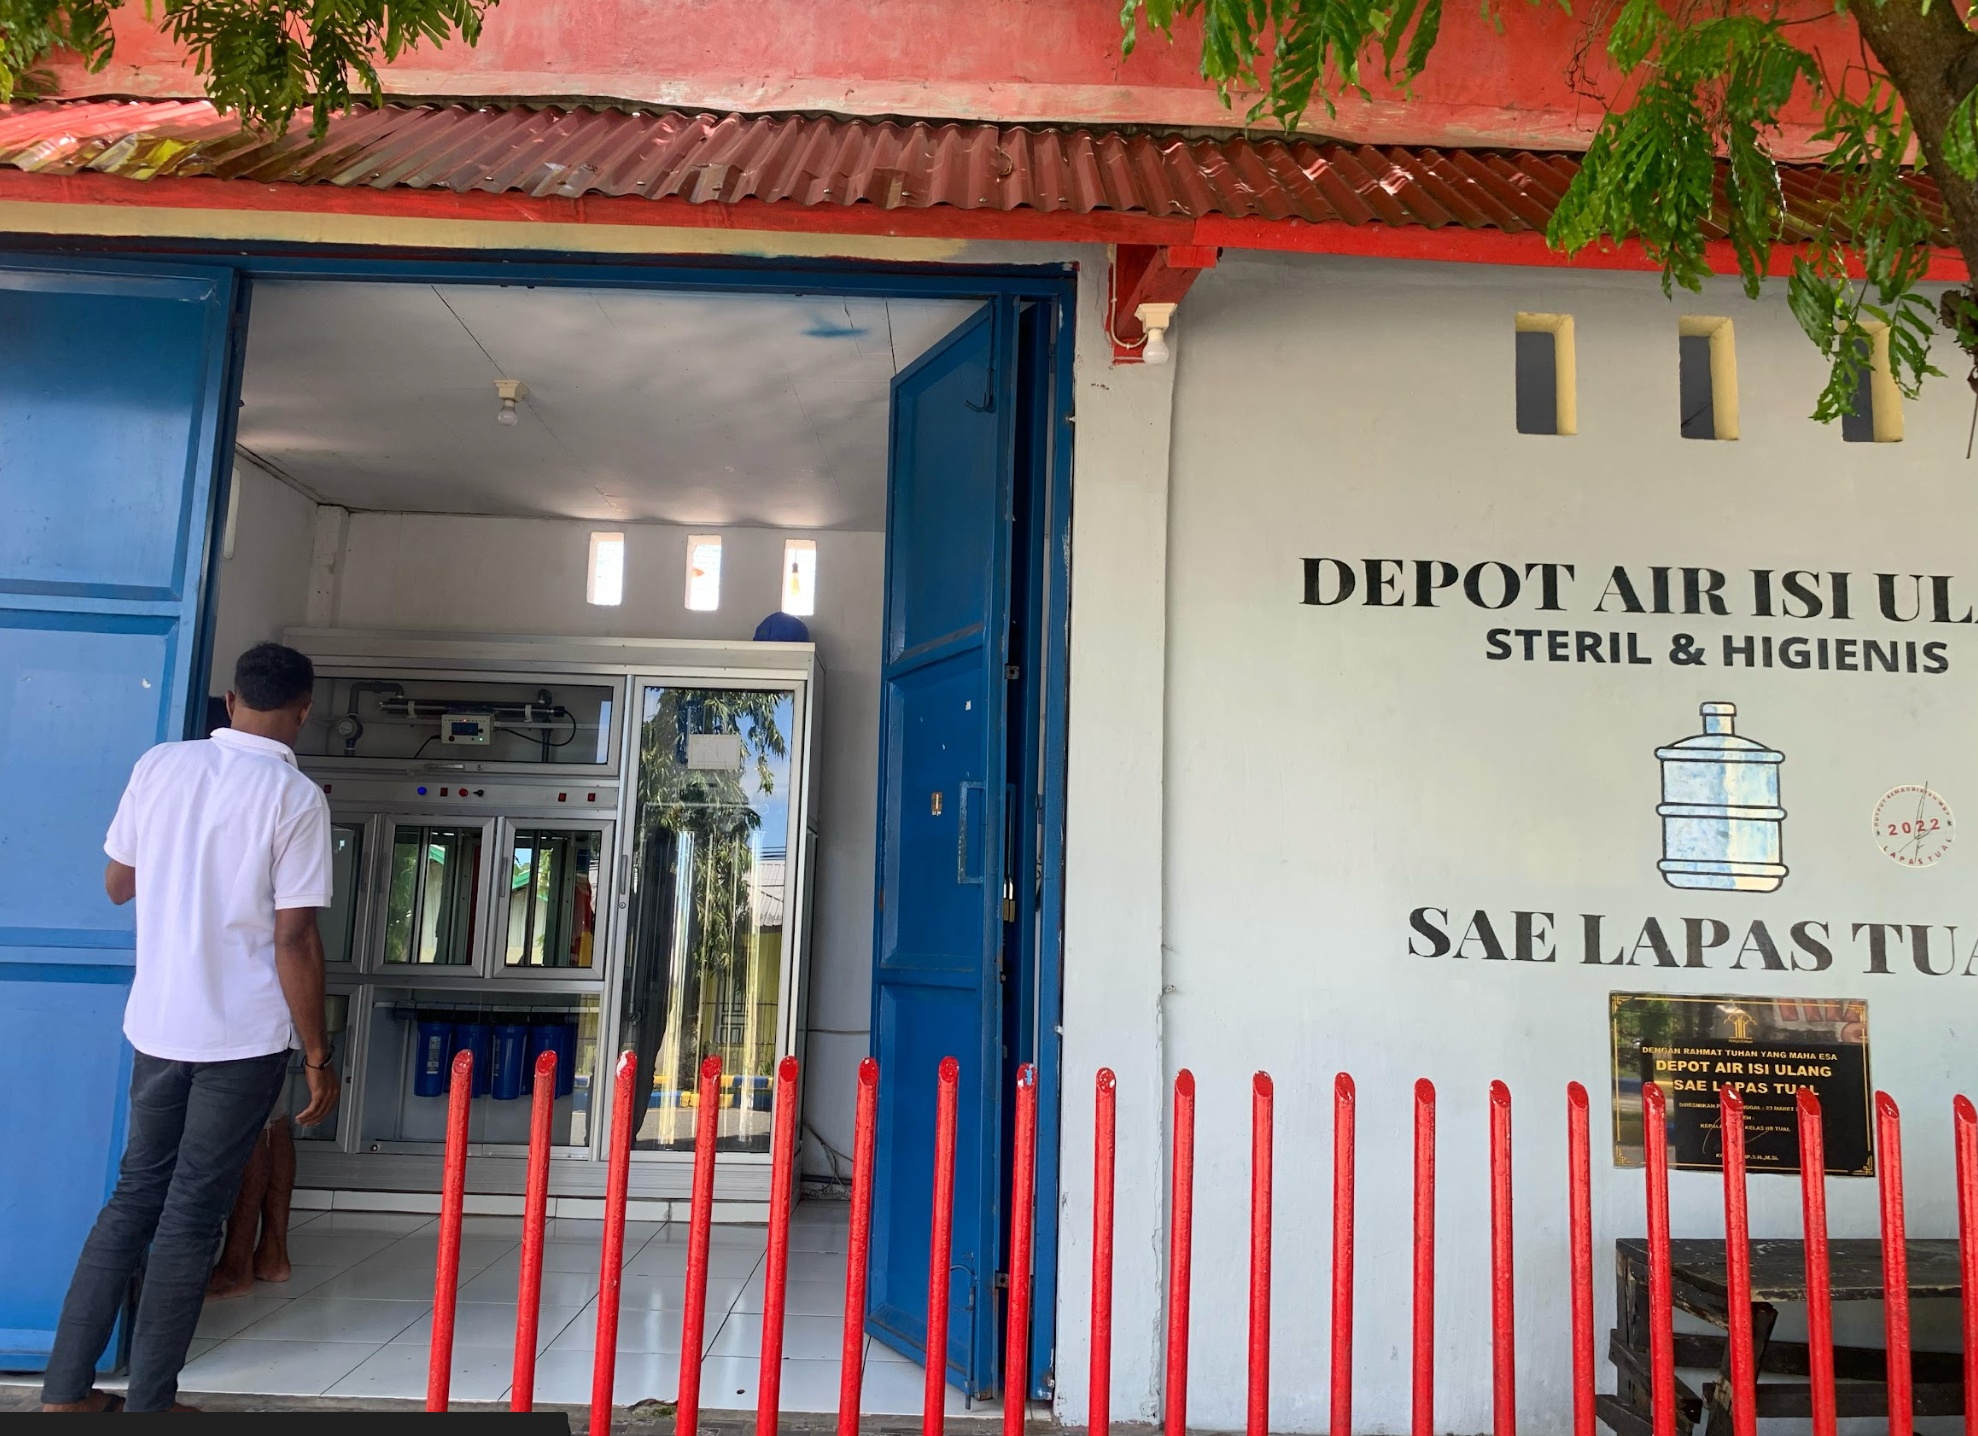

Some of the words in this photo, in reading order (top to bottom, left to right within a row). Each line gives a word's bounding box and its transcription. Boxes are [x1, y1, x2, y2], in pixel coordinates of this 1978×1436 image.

[1299, 557, 1574, 610] DEPOT
[1593, 565, 1733, 616] AIR
[1749, 569, 1855, 620] ISI
[1873, 573, 1978, 624] UL
[1486, 628, 1652, 664] STERIL
[1668, 633, 1707, 666] &
[1722, 634, 1950, 675] HIGIENIS
[1888, 818, 1941, 836] 2022
[1883, 845, 1924, 865] LAPAS
[1408, 906, 1557, 963] SAE
[1579, 914, 1834, 972] LAPAS
[1642, 1046, 1681, 1055] DENGAN
[1683, 1047, 1723, 1057] RAHMAT
[1725, 1049, 1758, 1058] TUHAN
[1761, 1050, 1787, 1059] YANG
[1789, 1051, 1817, 1060] MAHA
[1818, 1053, 1838, 1061] ESA
[1655, 1060, 1711, 1073] DEPOT
[1714, 1061, 1744, 1074] AIR
[1748, 1063, 1770, 1075] ISI
[1774, 1064, 1832, 1078] ULANG
[1673, 1079, 1708, 1092] SAE
[1712, 1080, 1769, 1094] LPAS
[1773, 1083, 1820, 1096] TUL
